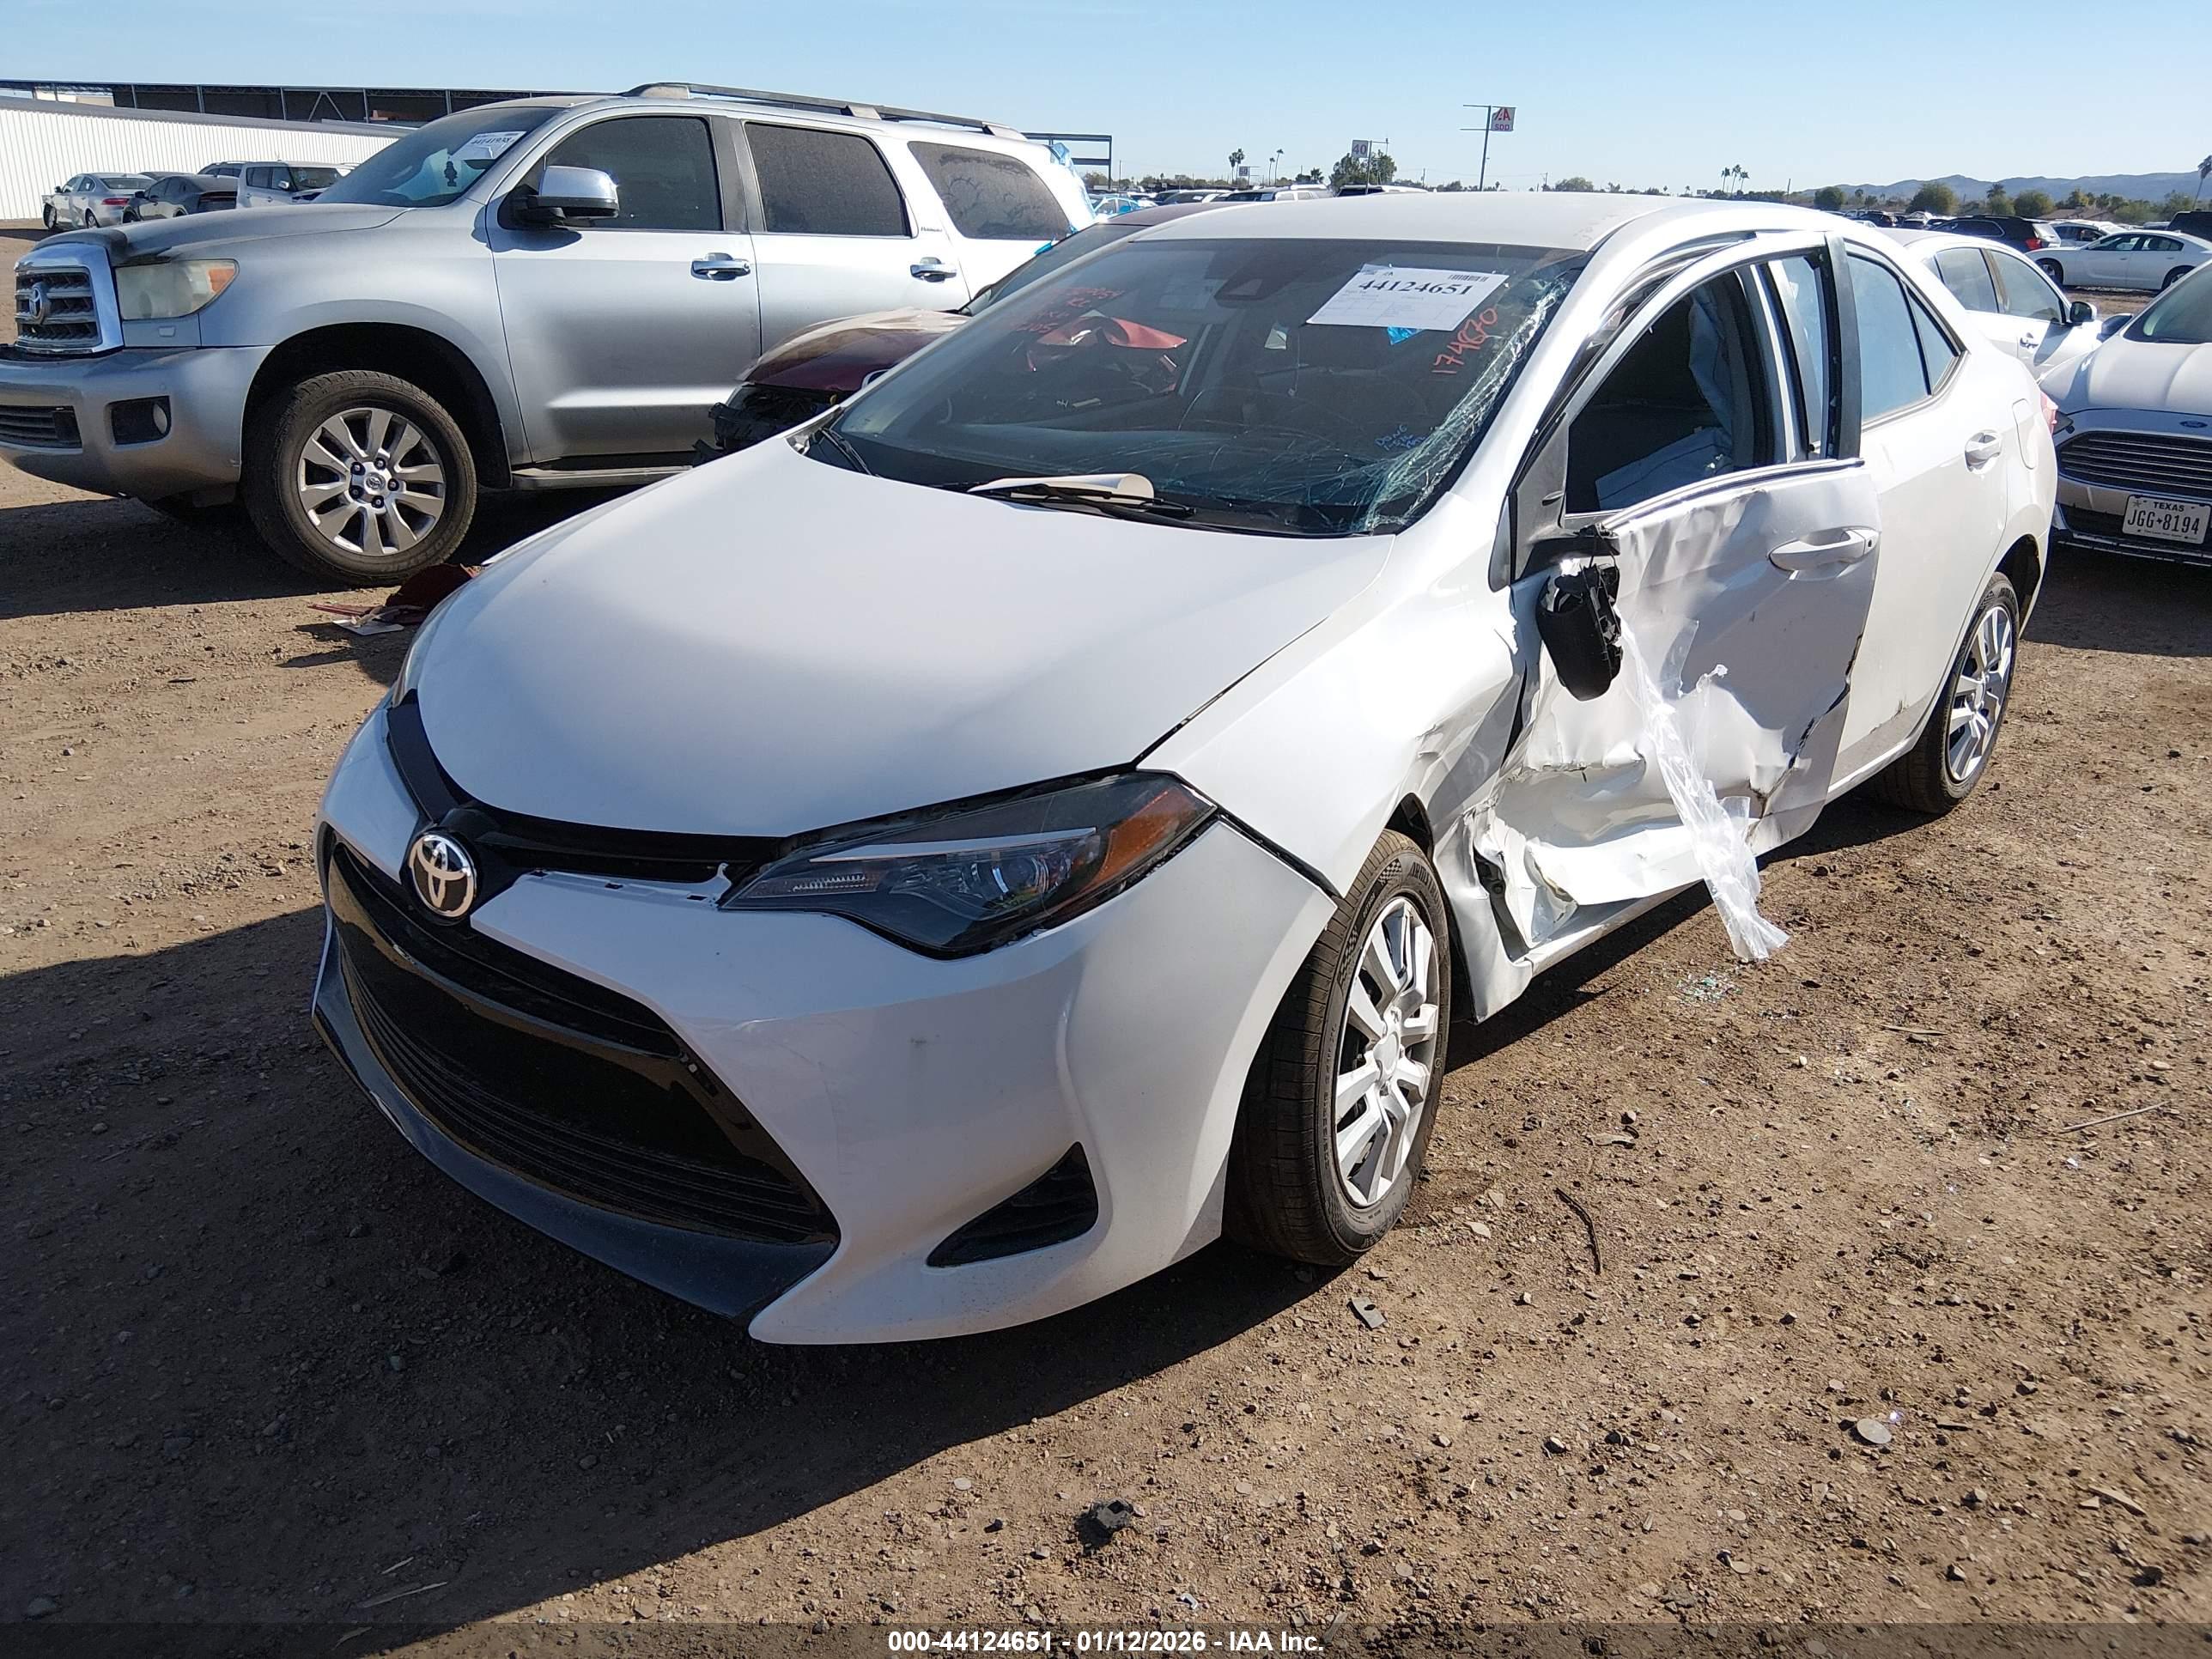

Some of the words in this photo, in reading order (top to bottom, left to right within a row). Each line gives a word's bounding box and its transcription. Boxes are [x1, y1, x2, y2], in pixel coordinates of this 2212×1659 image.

[1353, 143, 1367, 155] 40
[1358, 280, 1474, 295] 44124651
[2154, 501, 2185, 513] TEXAS
